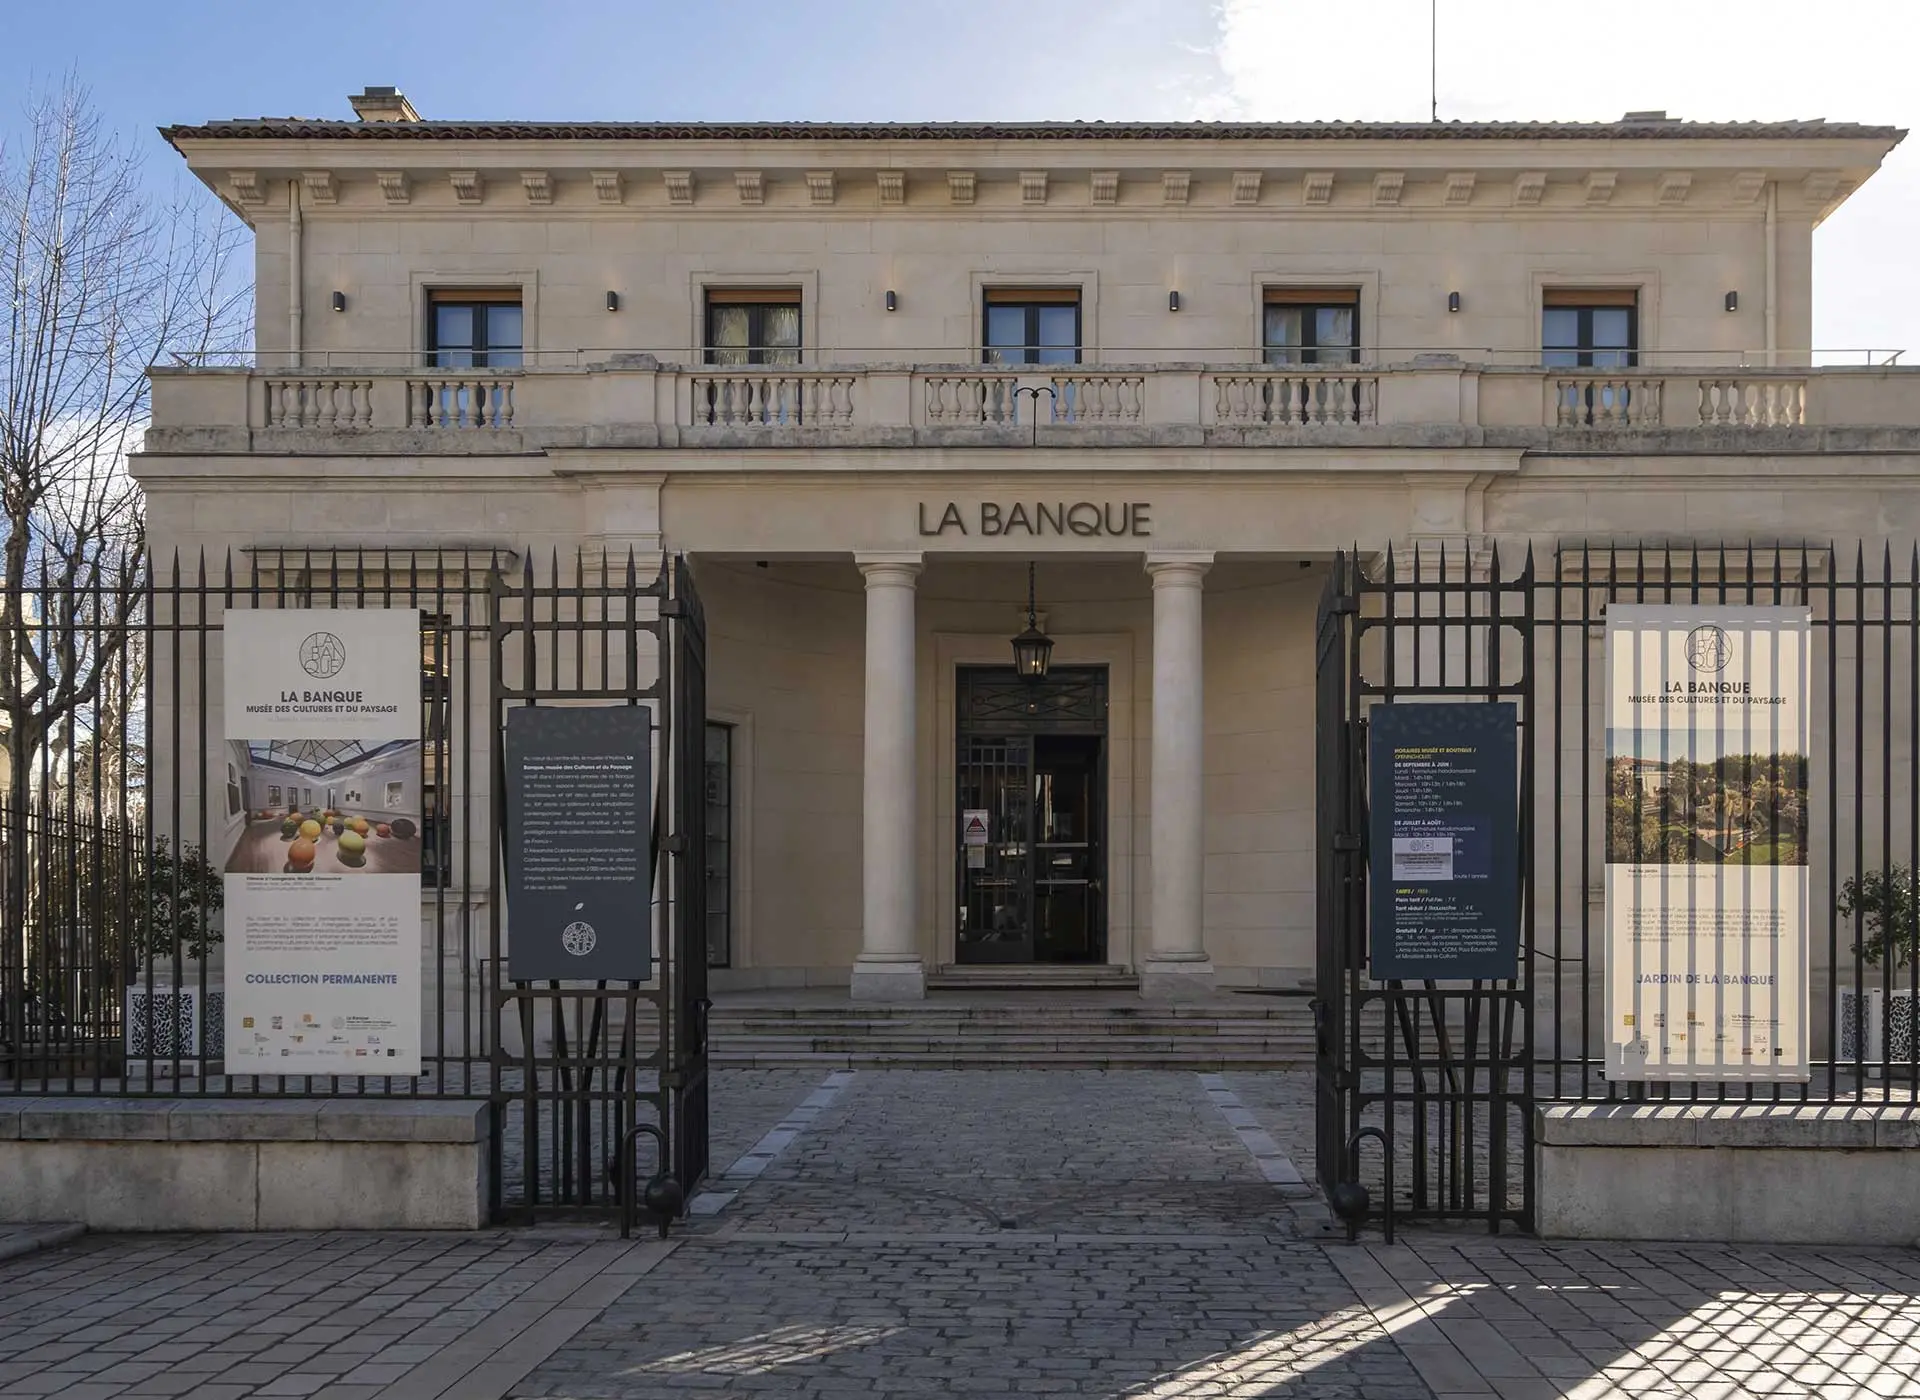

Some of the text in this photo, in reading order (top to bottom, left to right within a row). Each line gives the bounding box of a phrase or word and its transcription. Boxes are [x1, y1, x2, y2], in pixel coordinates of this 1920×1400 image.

[918, 502, 1151, 537] LA BANQUE
[1665, 682, 1751, 693] LA BANQUE
[280, 691, 363, 702] LA BANQUE
[1628, 695, 1656, 703] MUSÉE
[246, 704, 273, 712] MUSÉE
[246, 974, 397, 984] COLLECTION PERMANENTE
[1636, 974, 1774, 984] JARDIN DE LA BANQUE
